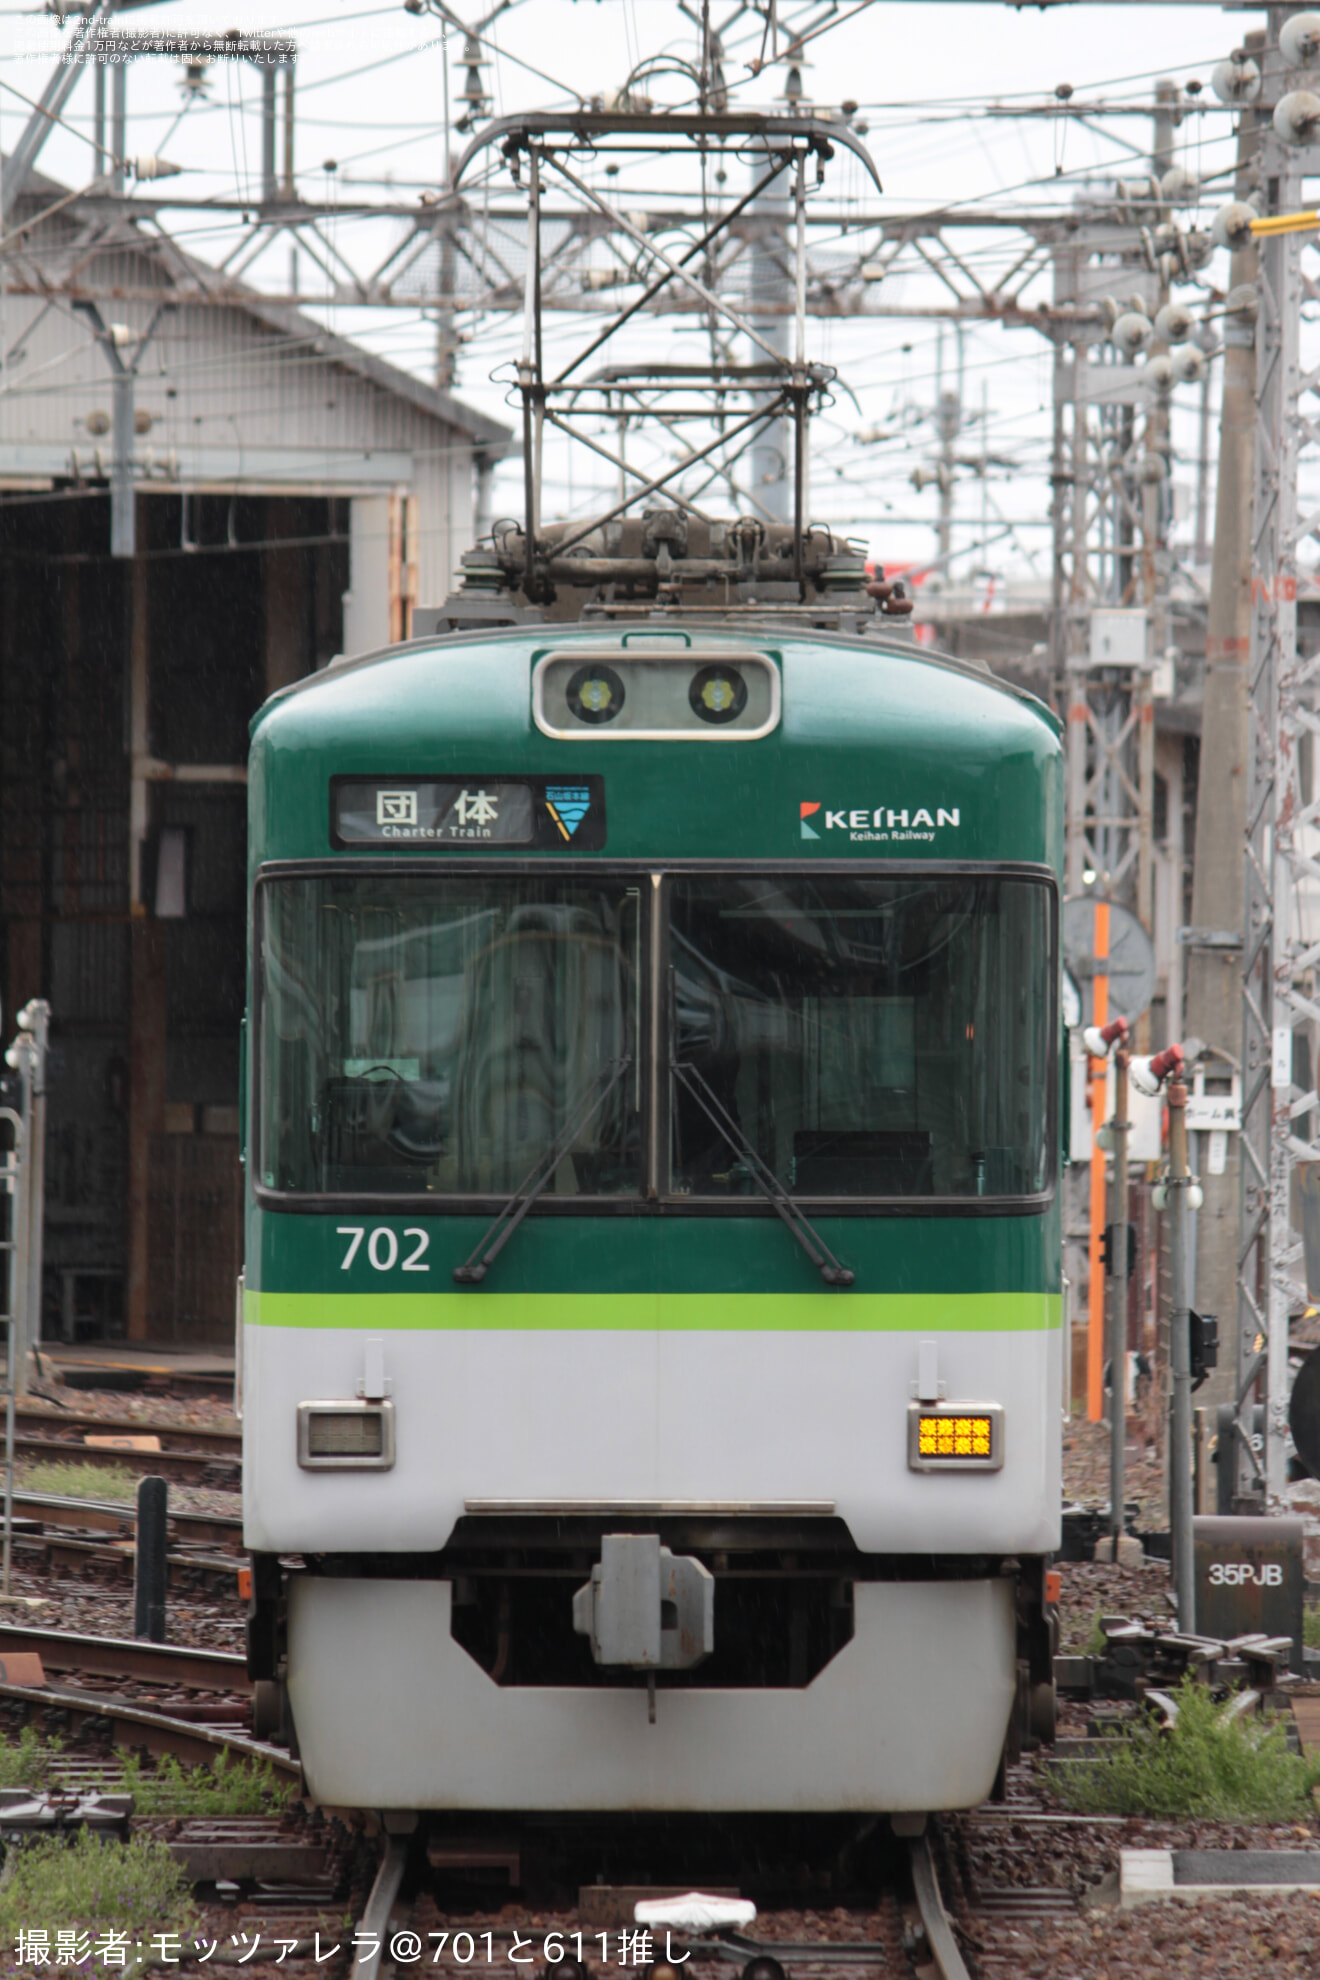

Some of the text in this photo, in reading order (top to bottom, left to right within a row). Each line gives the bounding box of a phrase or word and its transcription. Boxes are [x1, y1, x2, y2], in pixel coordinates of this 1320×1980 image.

[825, 807, 960, 828] KEIHAN
[381, 825, 491, 838] Charter Train
[849, 830, 936, 843] Keihan Railway
[336, 1226, 430, 1272] 702
[1208, 1562, 1283, 1587] 35PJB
